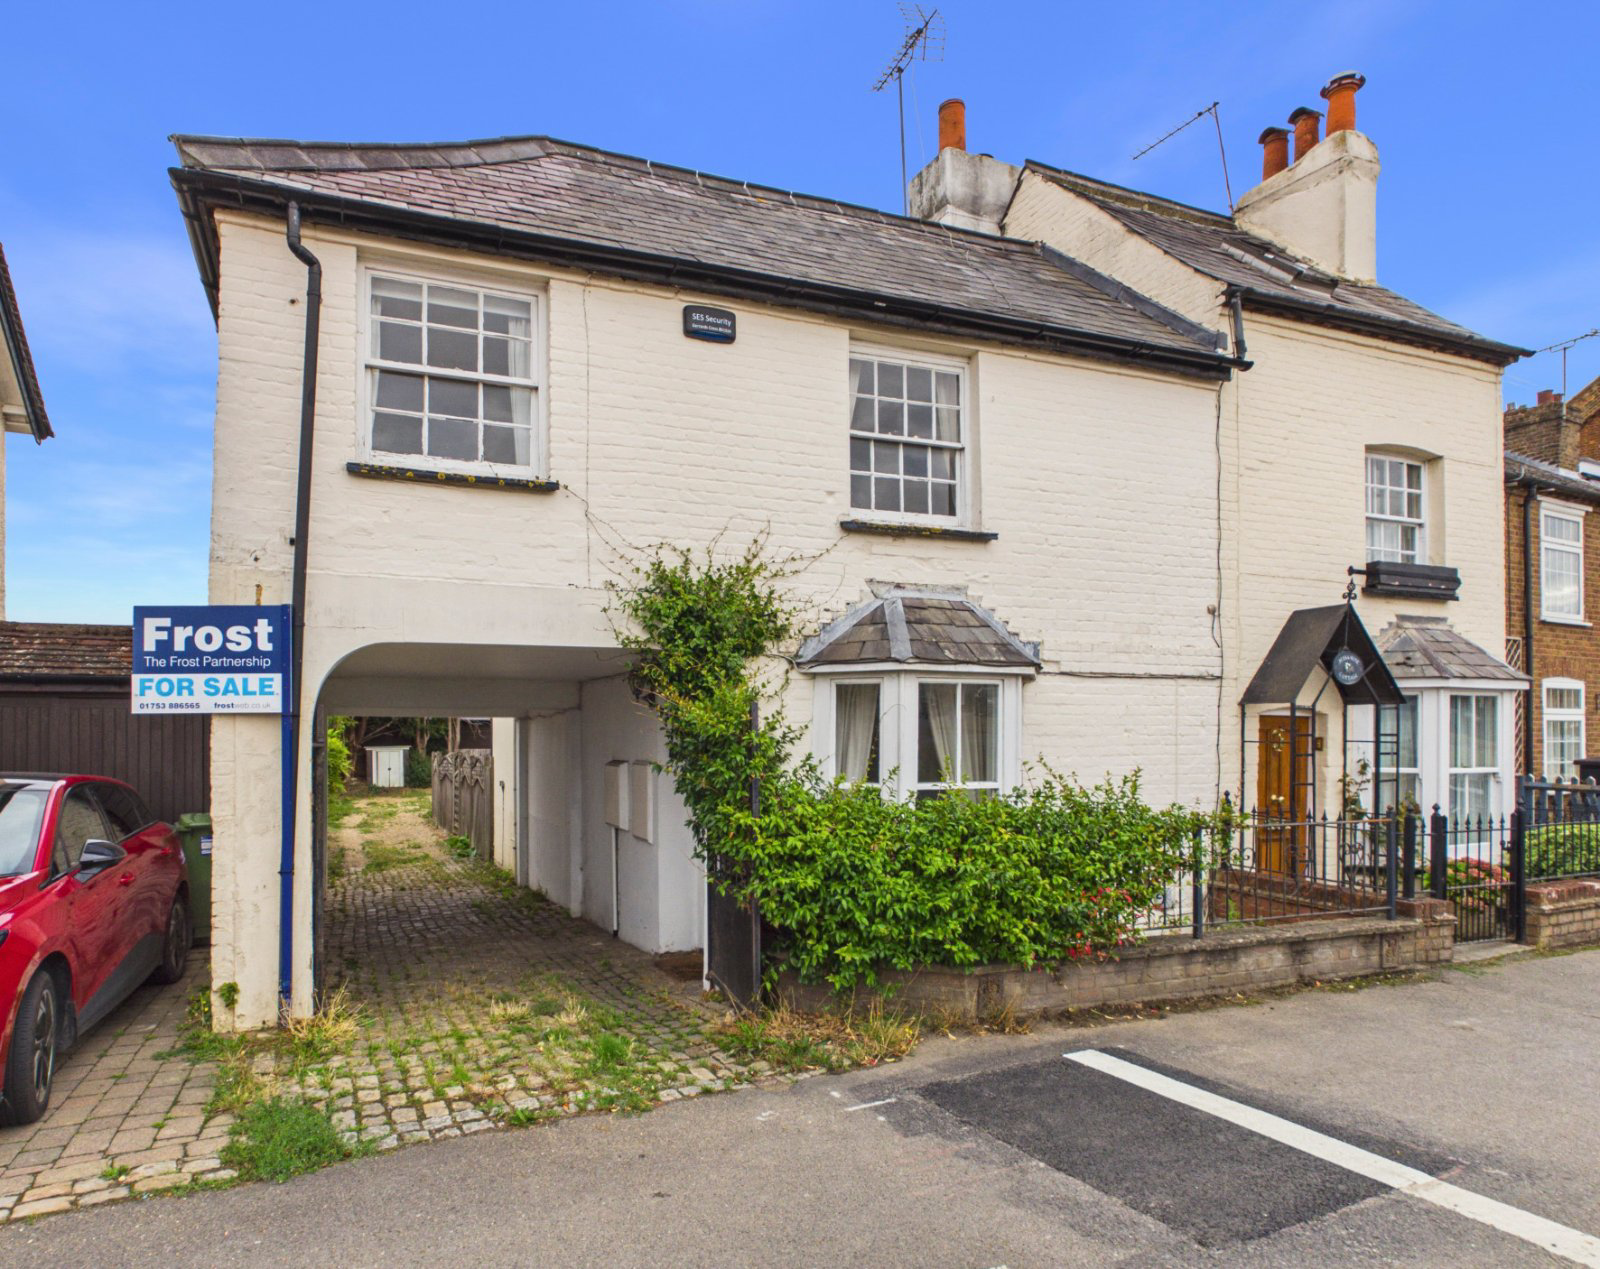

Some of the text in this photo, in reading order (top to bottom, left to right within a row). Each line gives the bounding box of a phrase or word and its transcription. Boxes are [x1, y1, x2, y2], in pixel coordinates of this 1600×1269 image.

[691, 312, 732, 328] SES Security
[143, 617, 273, 653] Frost
[144, 656, 271, 669] The Frost Partnership
[138, 677, 275, 697] FOR SALE
[139, 702, 201, 710] 01753 886565
